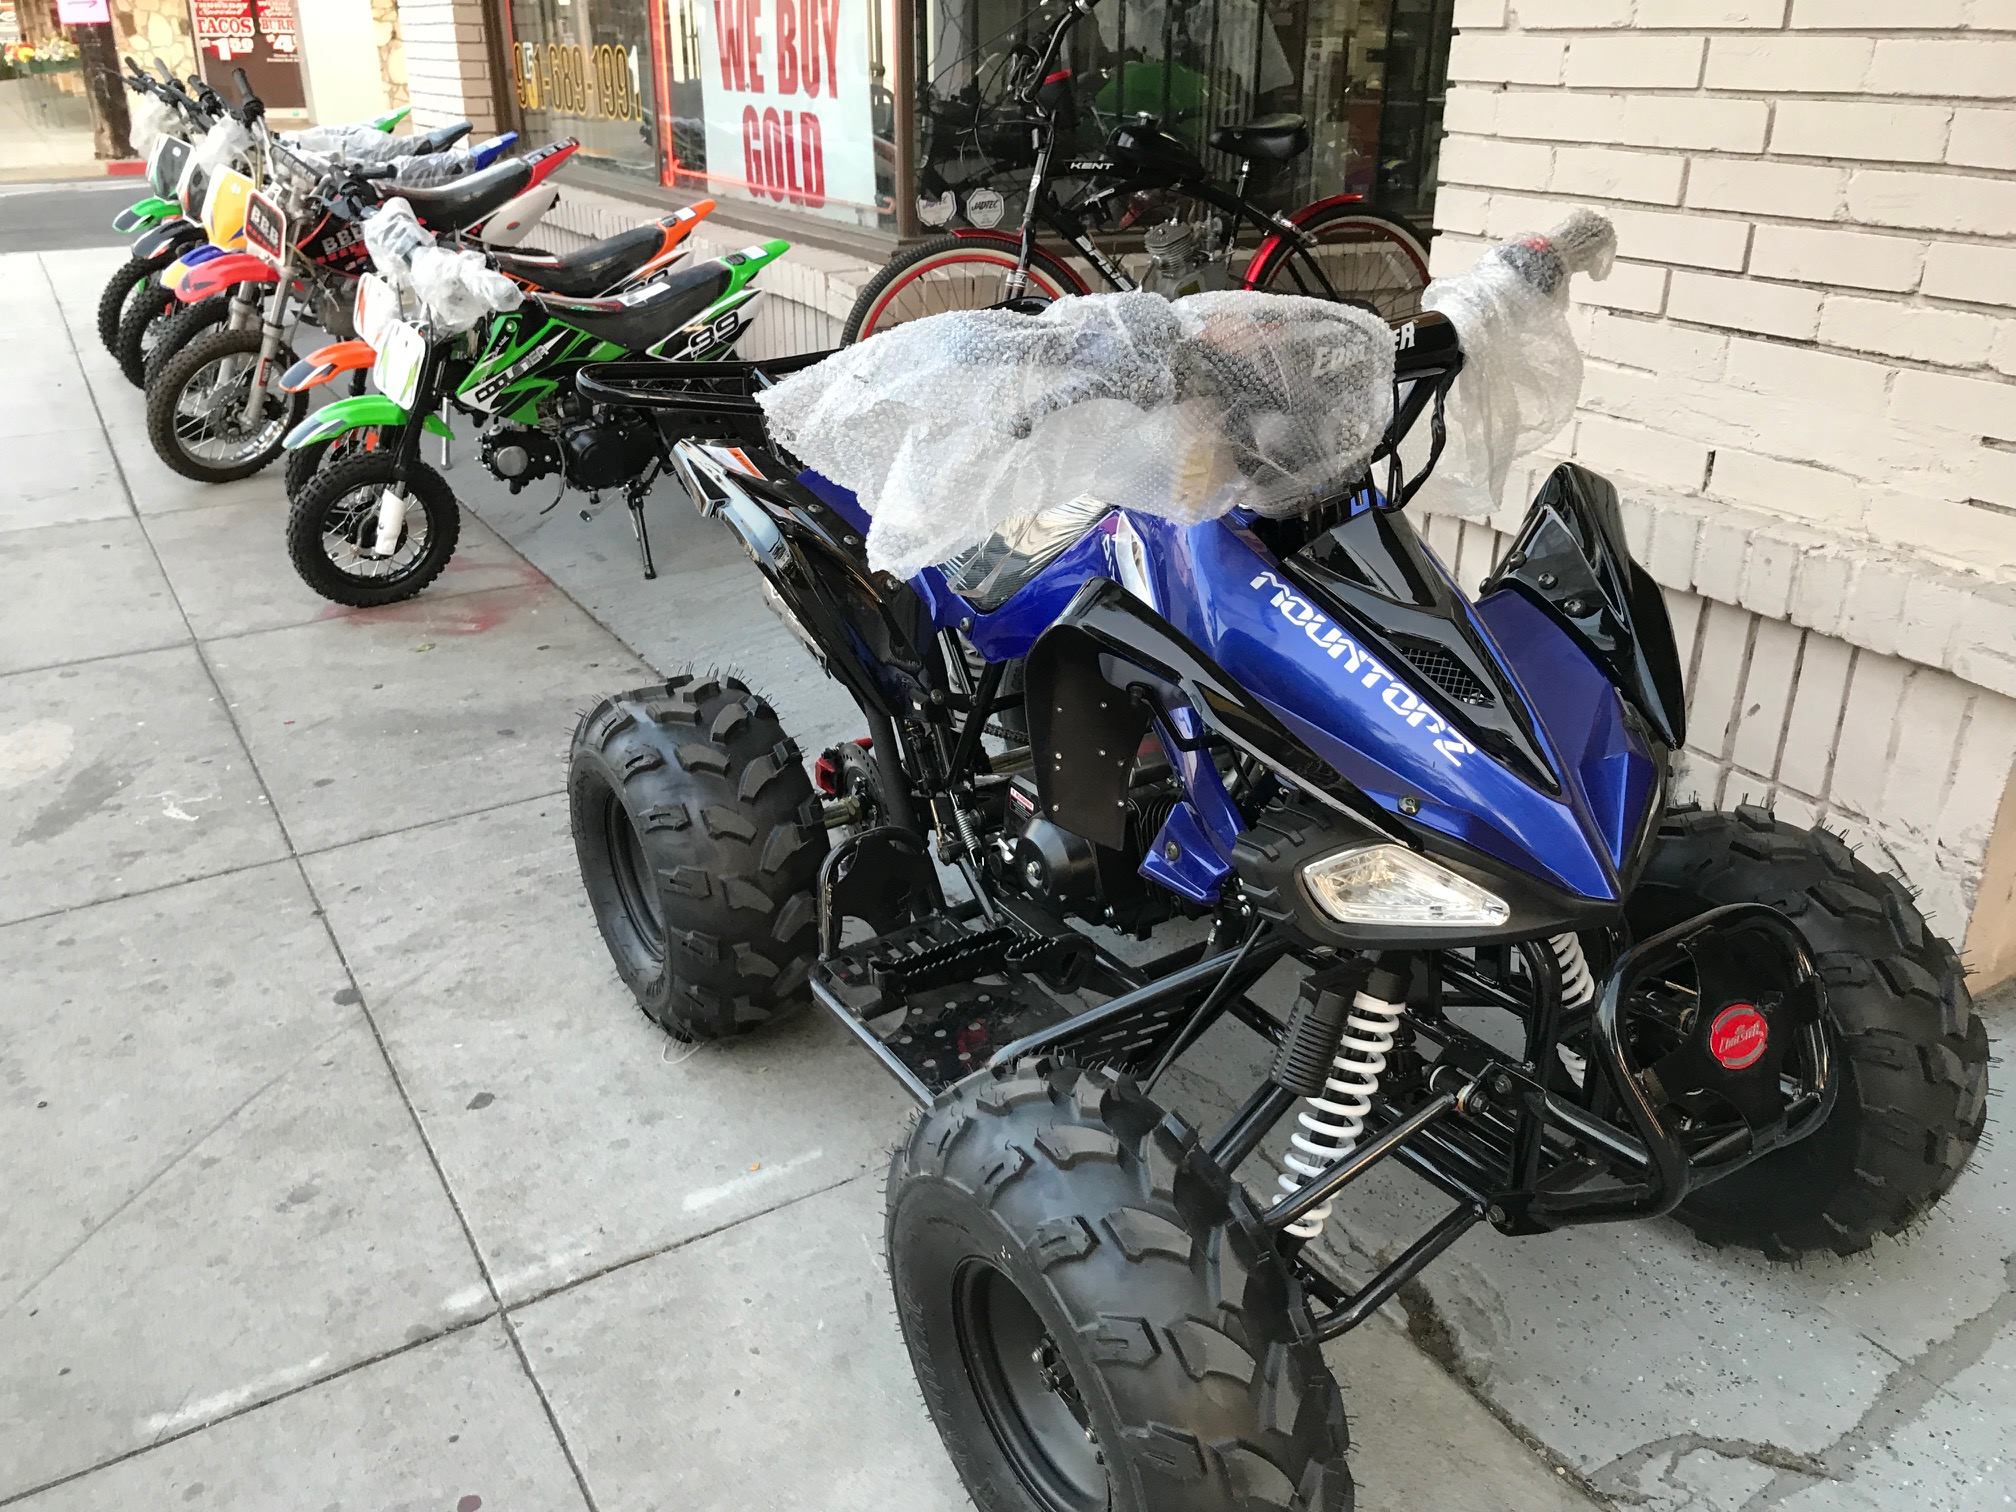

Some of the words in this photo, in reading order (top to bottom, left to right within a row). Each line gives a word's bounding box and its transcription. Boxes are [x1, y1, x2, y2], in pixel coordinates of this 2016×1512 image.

[197, 18, 254, 36] TACOS
[714, 0, 765, 94] WE
[776, 0, 839, 99] BUY
[742, 104, 824, 209] GOLD
[1070, 162, 1115, 170] KENT
